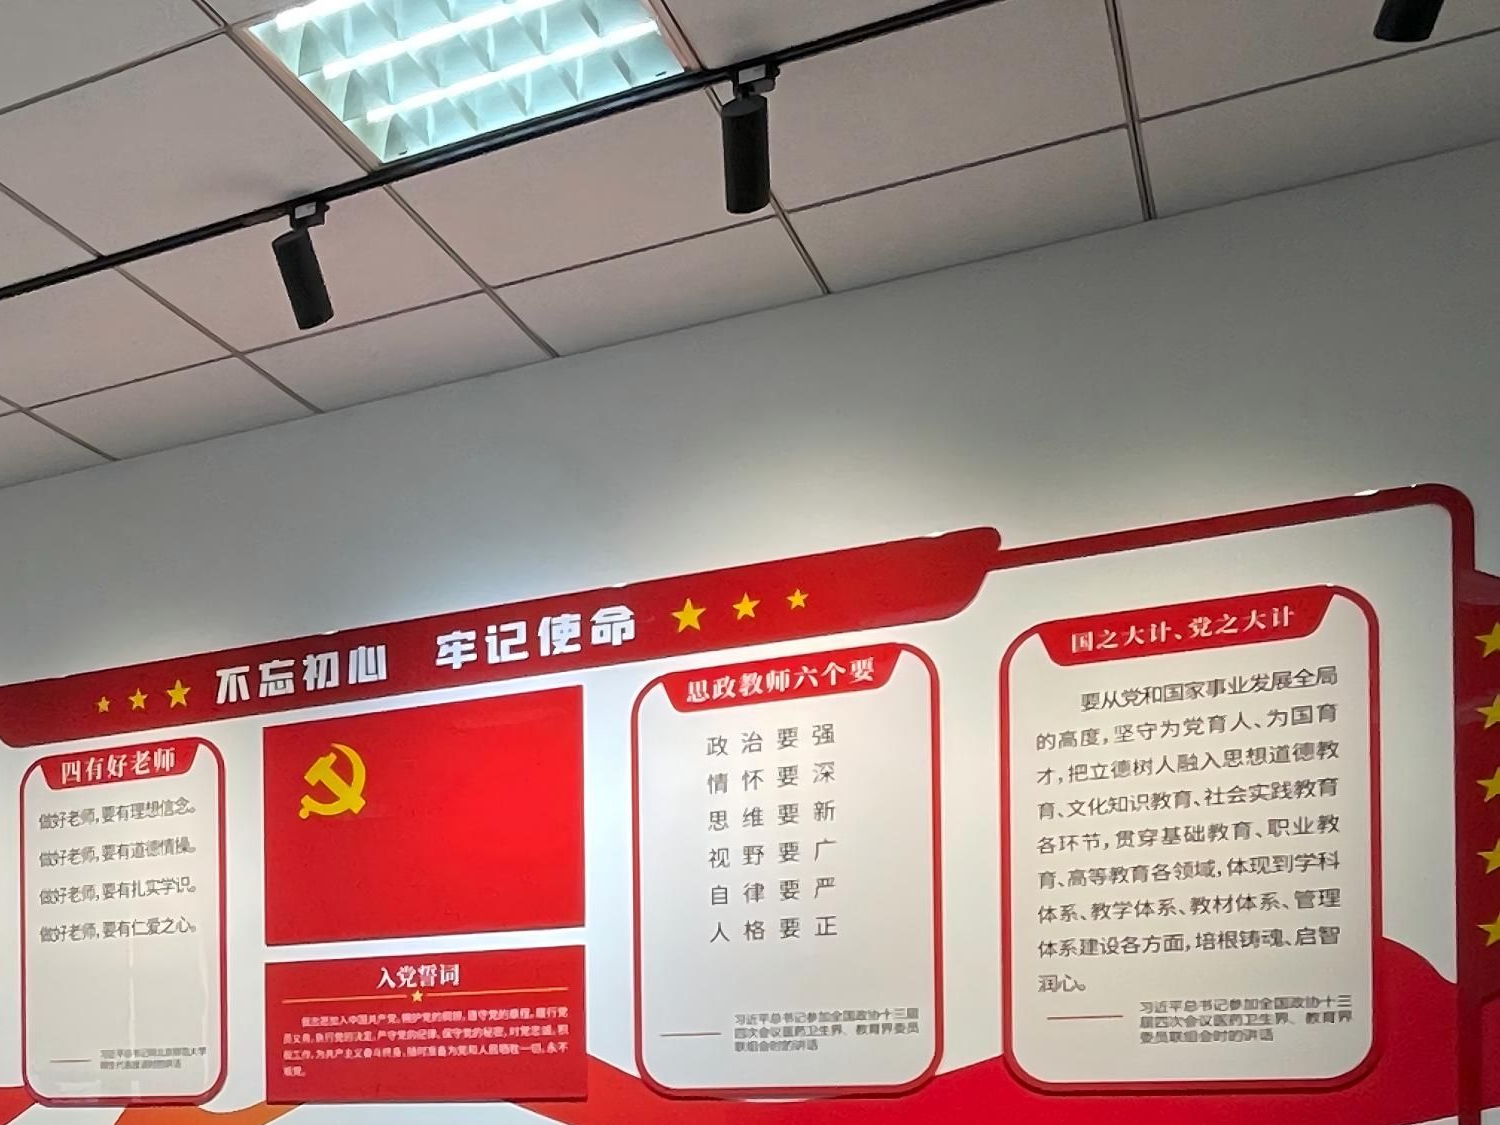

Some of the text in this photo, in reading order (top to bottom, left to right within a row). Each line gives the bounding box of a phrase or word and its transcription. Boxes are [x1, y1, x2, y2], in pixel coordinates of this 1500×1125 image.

[1071, 606, 1295, 653] 国之大计、党之大计
[215, 604, 636, 704] 不忘初心 牢记使命
[686, 657, 875, 703] 思政教师六个要
[1081, 666, 1338, 711] 要从党和国家事业发展全局
[706, 723, 836, 757] 政治要强
[1036, 703, 1338, 751] 的高度，坚守为党育人、为国育
[62, 748, 175, 784] 四有好老师
[707, 761, 836, 795] 情怀要深
[1036, 741, 1339, 785] 才，把立德树人融入思想道德教
[39, 796, 196, 829] 做好老师，要有理想信念。
[708, 799, 836, 832] 思维要新
[1038, 778, 1339, 821] 育、文化知识教育、社会实践教育
[1037, 814, 1340, 854] 各环节，贯穿基础教育、职业教
[708, 838, 837, 869] 视野要广
[1038, 851, 1340, 889] 育、高等教育各领域，体现到学科
[39, 876, 196, 905] 做好老师，要有扎实学识。
[710, 876, 836, 906] 自律要严
[1038, 888, 1340, 925] 体系、教学体系、教材体系、管理
[39, 916, 196, 943] 做好老师，要有仁爱之心。
[710, 915, 838, 943] 人格要正
[1038, 926, 1340, 959] 体系建设各方面，培根铸魂、启智
[376, 963, 460, 989] 入党誓词
[1038, 974, 1086, 993] 润心。
